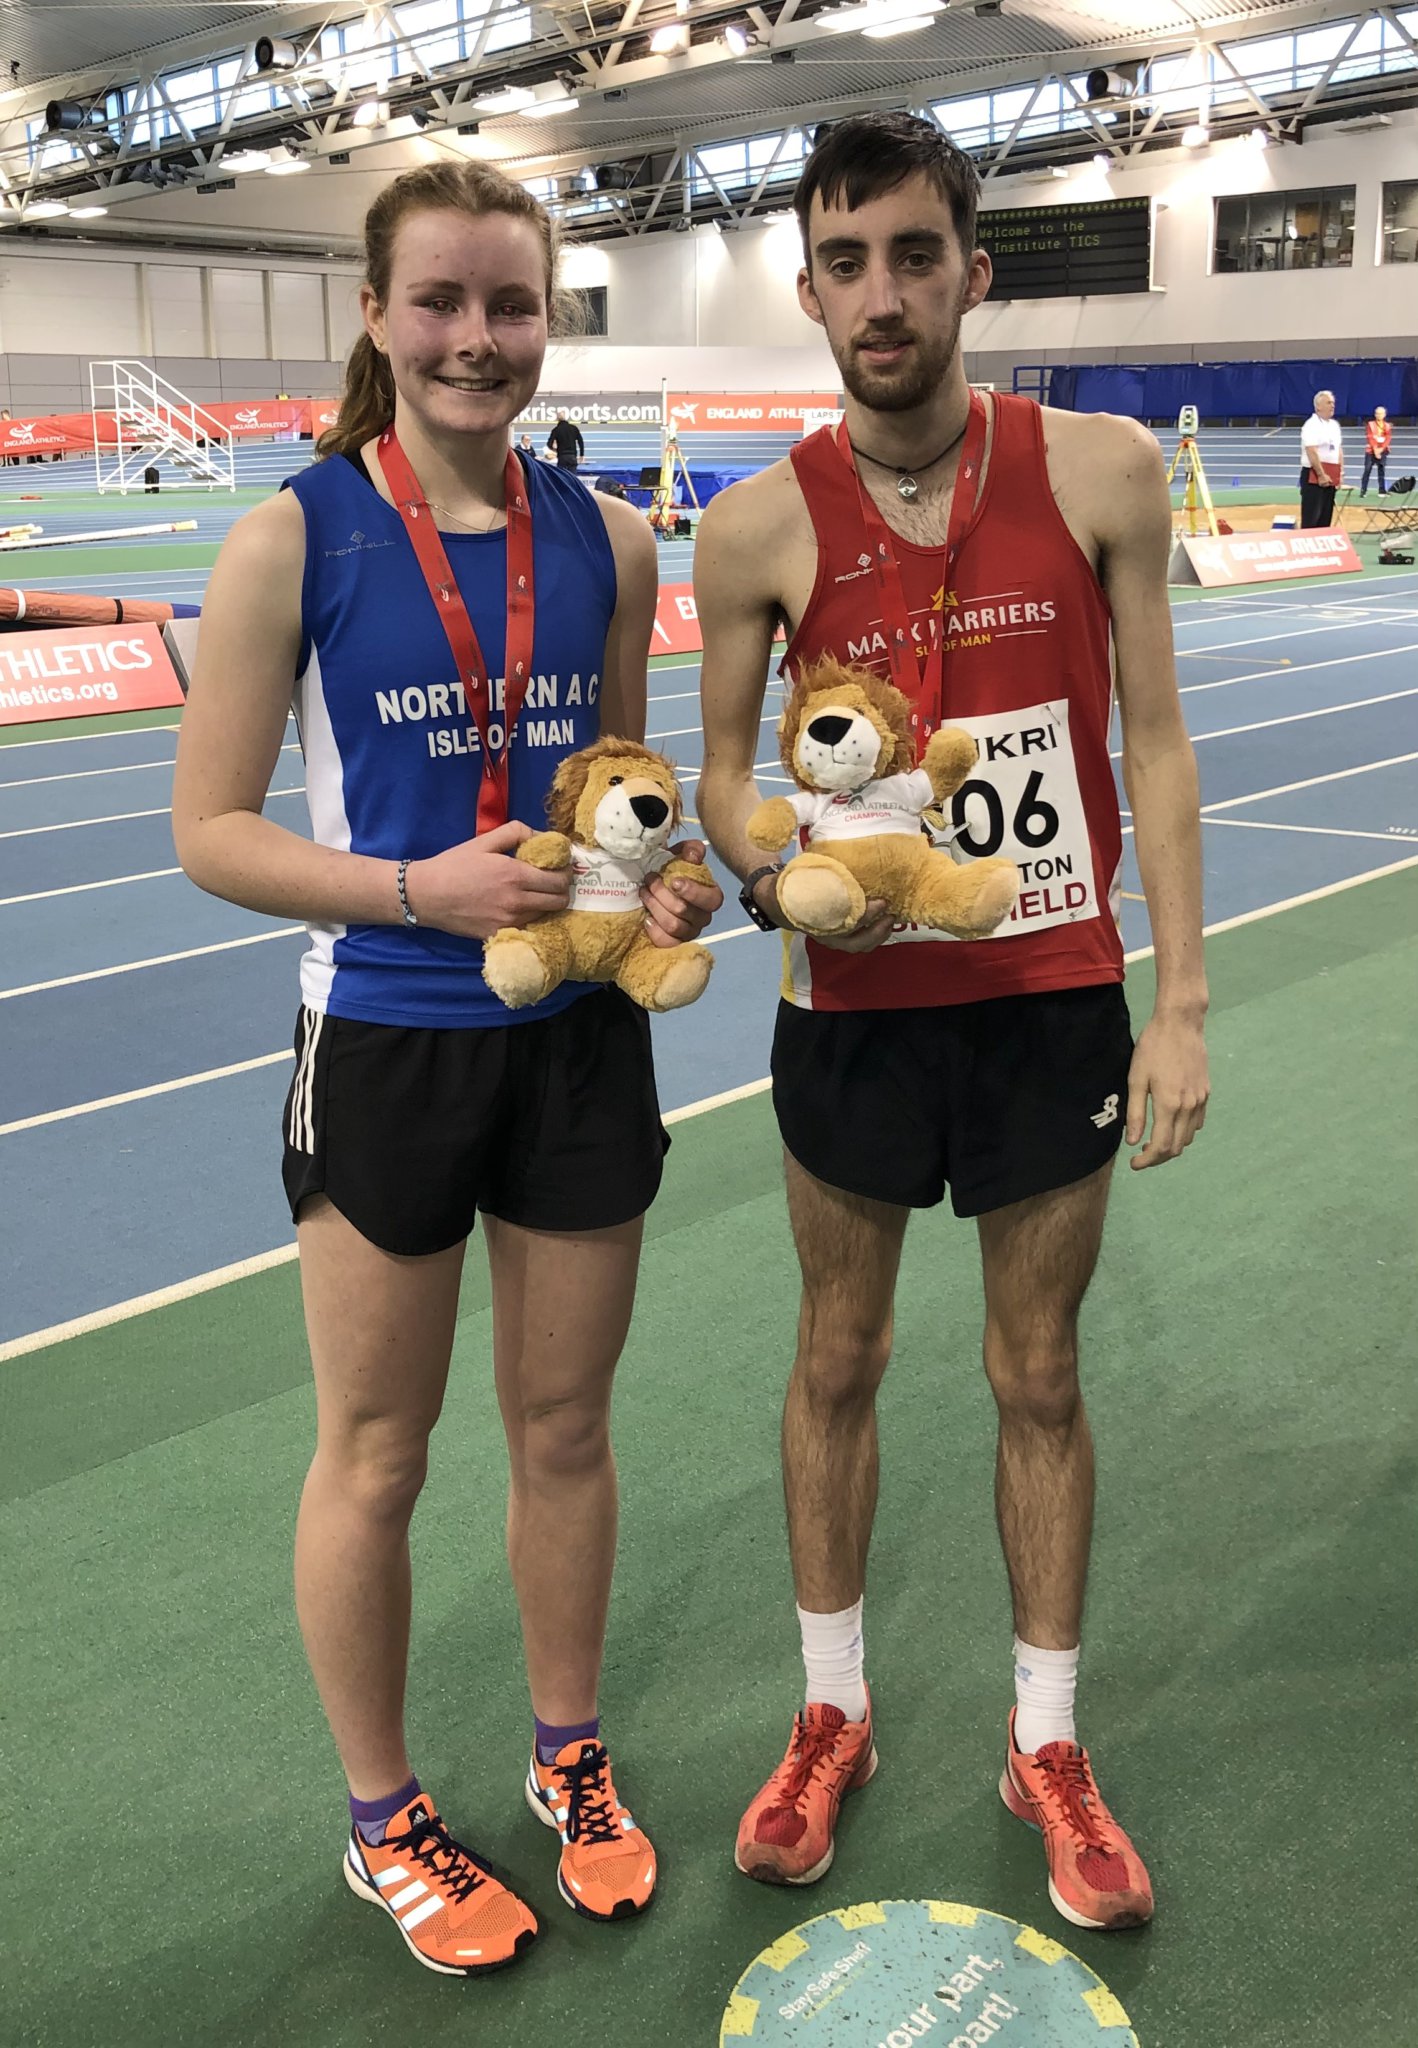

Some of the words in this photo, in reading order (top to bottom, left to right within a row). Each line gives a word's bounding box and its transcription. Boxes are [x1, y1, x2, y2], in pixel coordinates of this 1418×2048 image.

[979, 226, 1031, 239] Welcome
[1040, 224, 1054, 234] to
[1063, 220, 1085, 232] the
[994, 239, 1061, 253] Institute
[1070, 235, 1100, 247] TICS
[518, 402, 661, 423] krisports.com
[707, 407, 762, 419] ENGLAND
[811, 411, 834, 419] LAPS
[230, 422, 258, 430] ENGLAND
[258, 421, 289, 429] ATHLETICS
[4, 439, 34, 448] ENGLAND
[33, 435, 66, 444] ATHLETICS
[1228, 540, 1288, 561] ENGLAND
[1291, 534, 1349, 555] ATHLETICS
[847, 621, 922, 660] MAX
[960, 633, 992, 648] MAN
[565, 673, 582, 706] A
[587, 673, 599, 706] C
[427, 726, 481, 758] ISLE
[526, 718, 575, 748] MAN
[844, 811, 891, 822] CHAMPION
[948, 770, 1060, 858] 06
[1017, 854, 1073, 884] TON
[577, 888, 627, 897] CHAMPION
[778, 1992, 815, 2020] Stay
[806, 1970, 841, 1996] Safe
